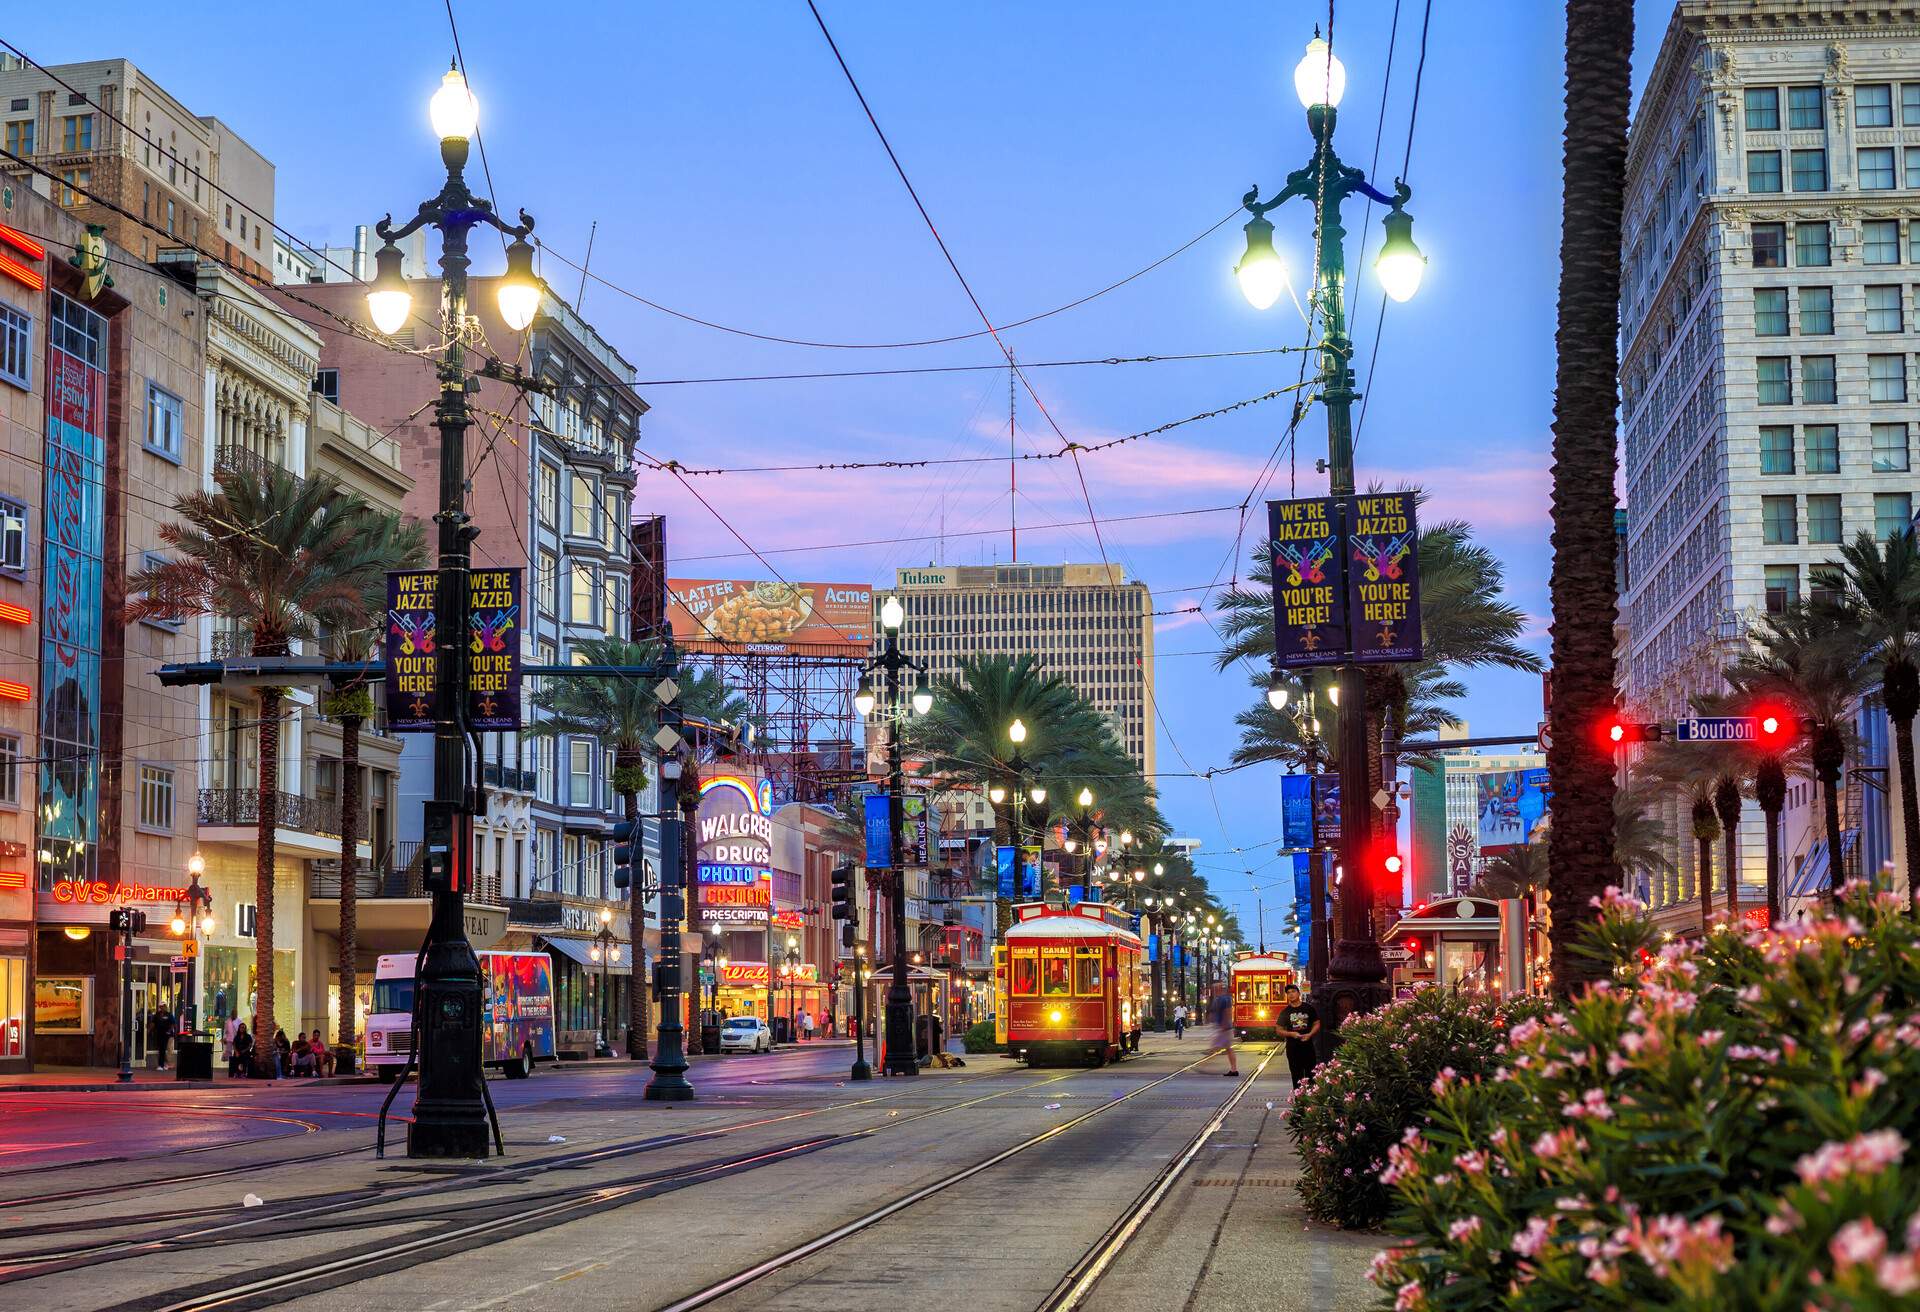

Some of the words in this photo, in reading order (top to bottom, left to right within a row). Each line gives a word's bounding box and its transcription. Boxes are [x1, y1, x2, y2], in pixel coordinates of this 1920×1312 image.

[1281, 503, 1326, 521] WE'RE
[1358, 498, 1404, 516] WE'RE
[1280, 522, 1329, 541] JAZZED
[1356, 517, 1407, 535] JAZZED
[470, 573, 511, 590] WE'RE
[901, 572, 946, 584] Tulane
[471, 591, 513, 608] AZZED
[670, 581, 734, 606] PLATTER
[825, 587, 870, 603] Acme
[1282, 587, 1334, 607] YOU'RE
[1359, 583, 1411, 601] YOU'RE
[396, 593, 434, 610] JAZZE
[689, 599, 714, 615] UP!
[1288, 606, 1330, 625] HERE!
[1365, 602, 1407, 620] HERE!
[1305, 650, 1337, 659] ORLEANS
[1381, 647, 1413, 655] ORLEANS
[394, 657, 437, 673] YOU'R
[470, 655, 512, 672] OU'RE
[470, 674, 508, 690] HERE!
[1690, 719, 1753, 739] Bourbon
[1284, 798, 1310, 808] UMC
[918, 821, 927, 863] HEALING
[716, 846, 769, 863] DRUGS
[701, 866, 752, 882] PHOTO
[1455, 844, 1468, 898] SAEN
[54, 881, 189, 902] CVS/pharma
[465, 916, 488, 935] VEAU
[561, 908, 580, 930] ORTS
[582, 910, 600, 932] PLUS
[185, 944, 193, 953] K
